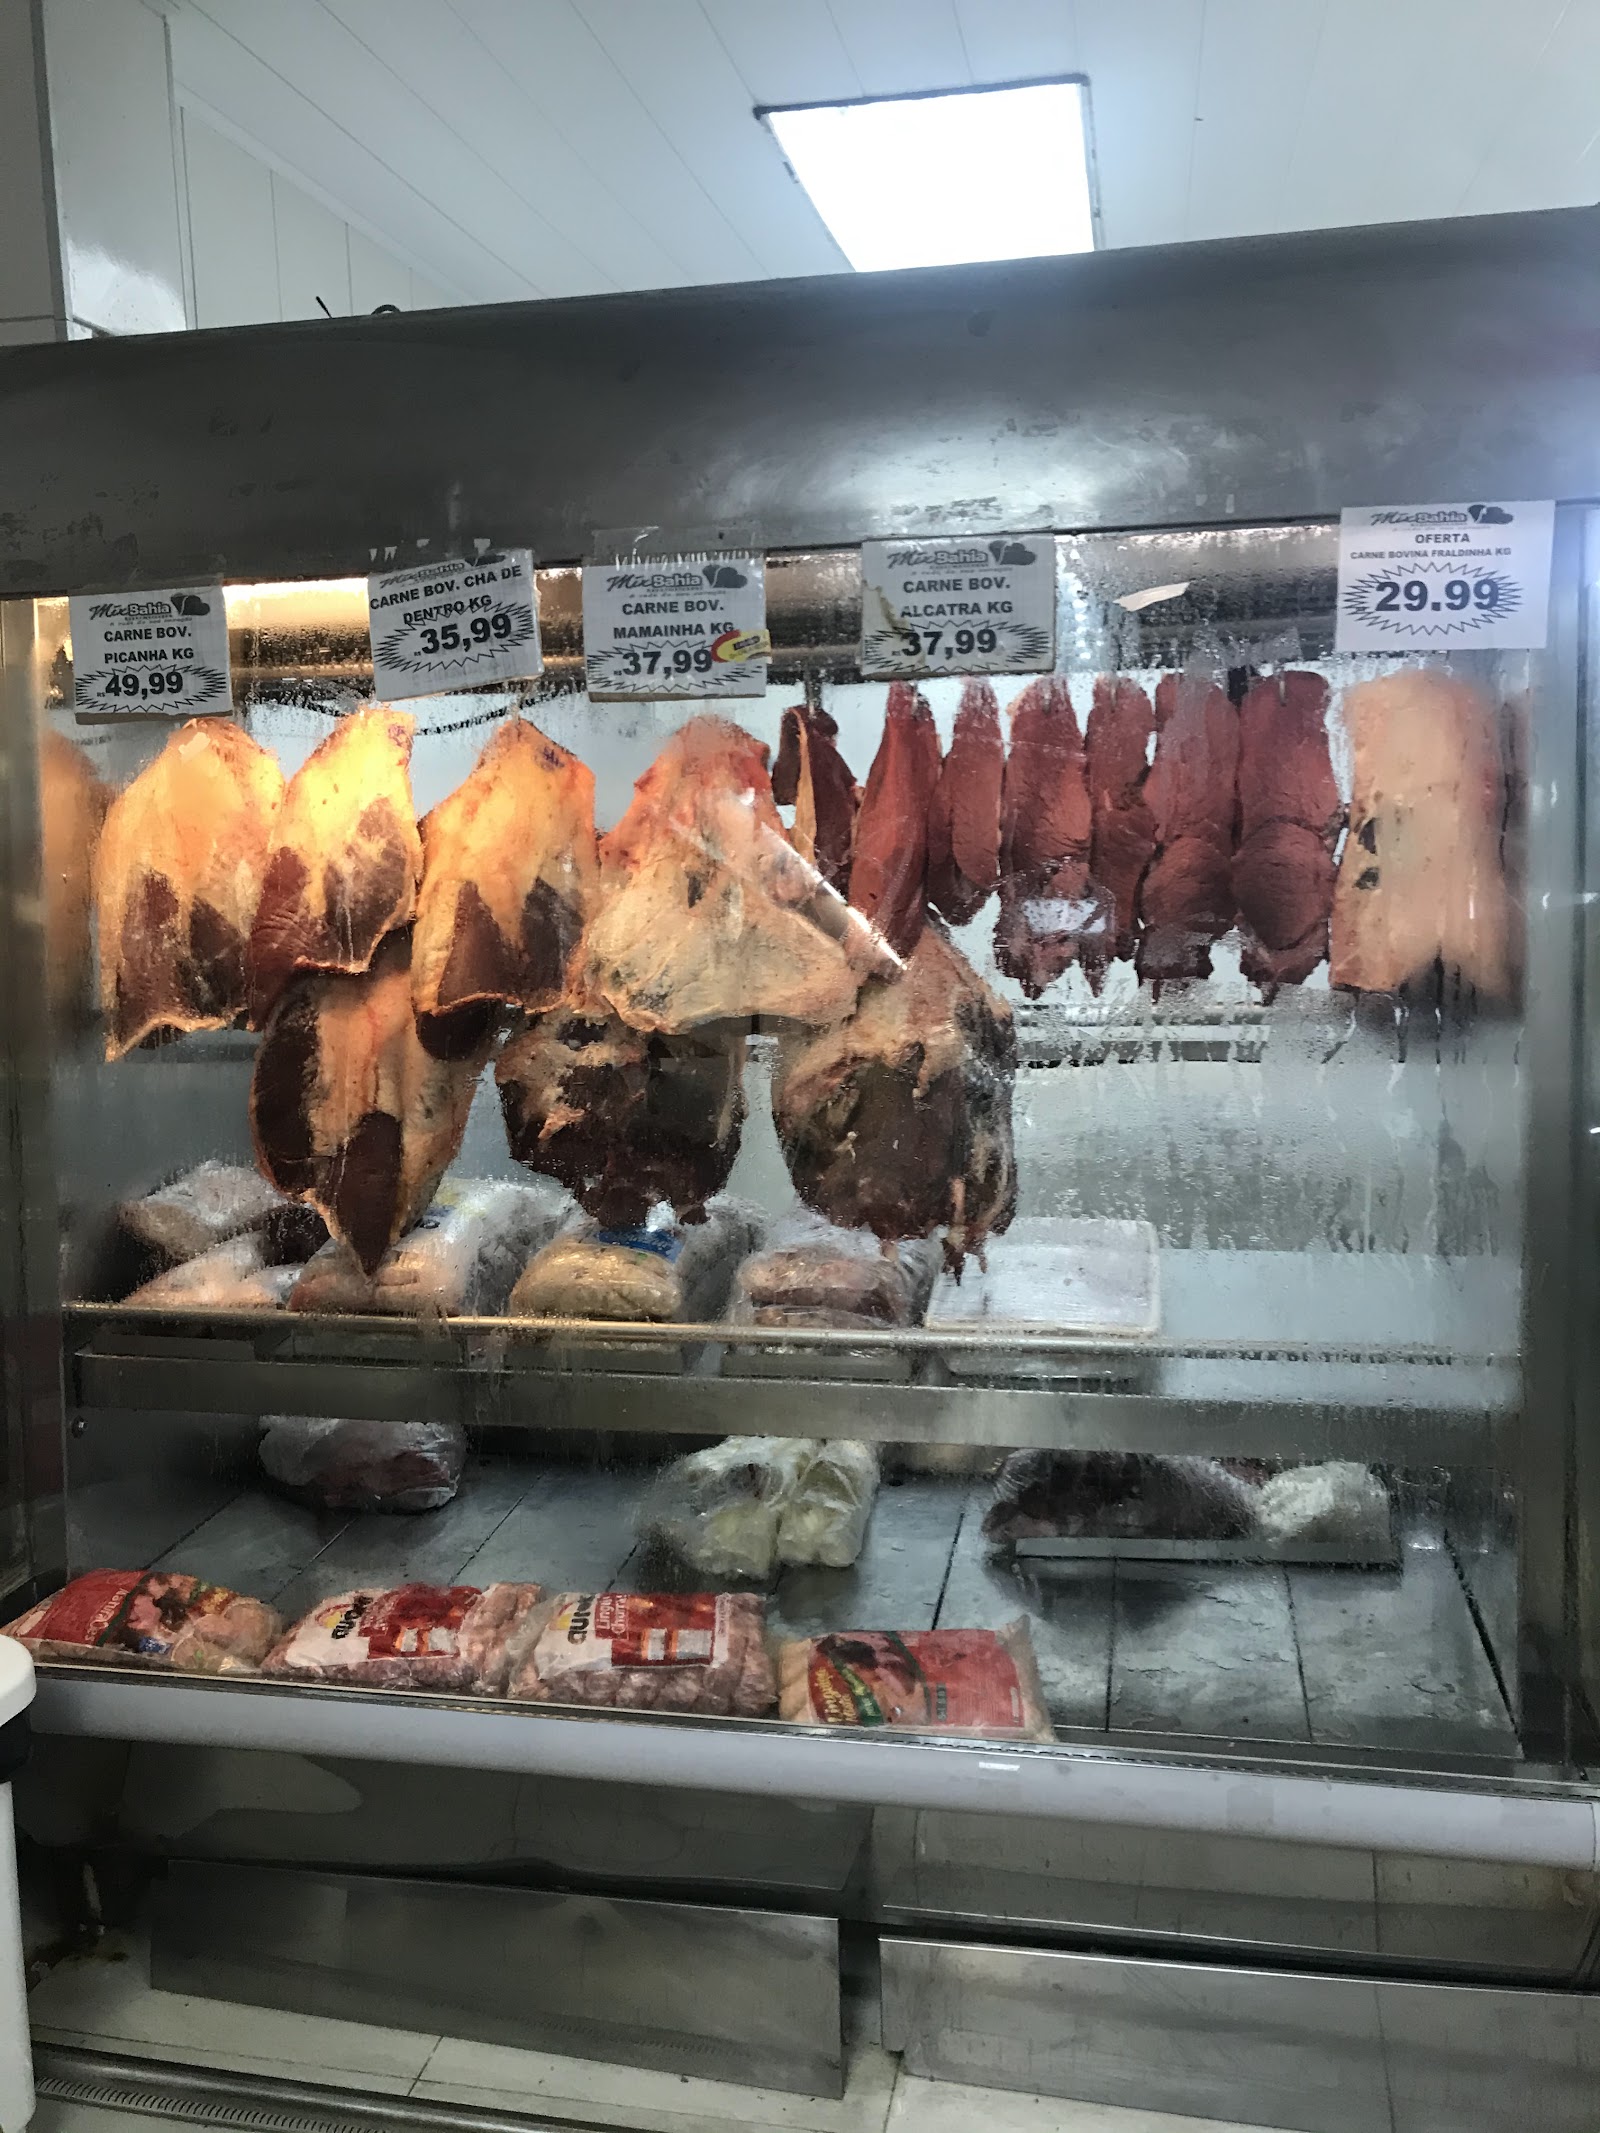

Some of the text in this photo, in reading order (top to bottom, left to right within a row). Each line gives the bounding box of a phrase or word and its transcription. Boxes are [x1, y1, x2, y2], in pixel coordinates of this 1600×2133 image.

[1415, 533, 1471, 544] OFERTA
[1350, 547, 1512, 560] CARNE BOVINA FRALDINHA KG
[370, 588, 420, 609] CARNE
[424, 579, 460, 597] BOV.
[464, 571, 498, 588] CHA
[501, 565, 522, 580] DE
[903, 577, 1011, 593] CARNE BOV.
[1375, 578, 1501, 612] 29.99
[403, 594, 492, 625] DENTRO KG
[622, 599, 724, 615] CARNE BOV.
[901, 601, 1013, 618] ALCATRA KG
[104, 626, 192, 642] CARNE BOV.
[420, 613, 512, 654] 35,99
[613, 622, 734, 639] MAMAINHA KG
[901, 628, 997, 660] 37,99
[104, 647, 194, 664] PICANHA KG
[622, 649, 713, 680] 37,99
[105, 671, 183, 701] 49,99
